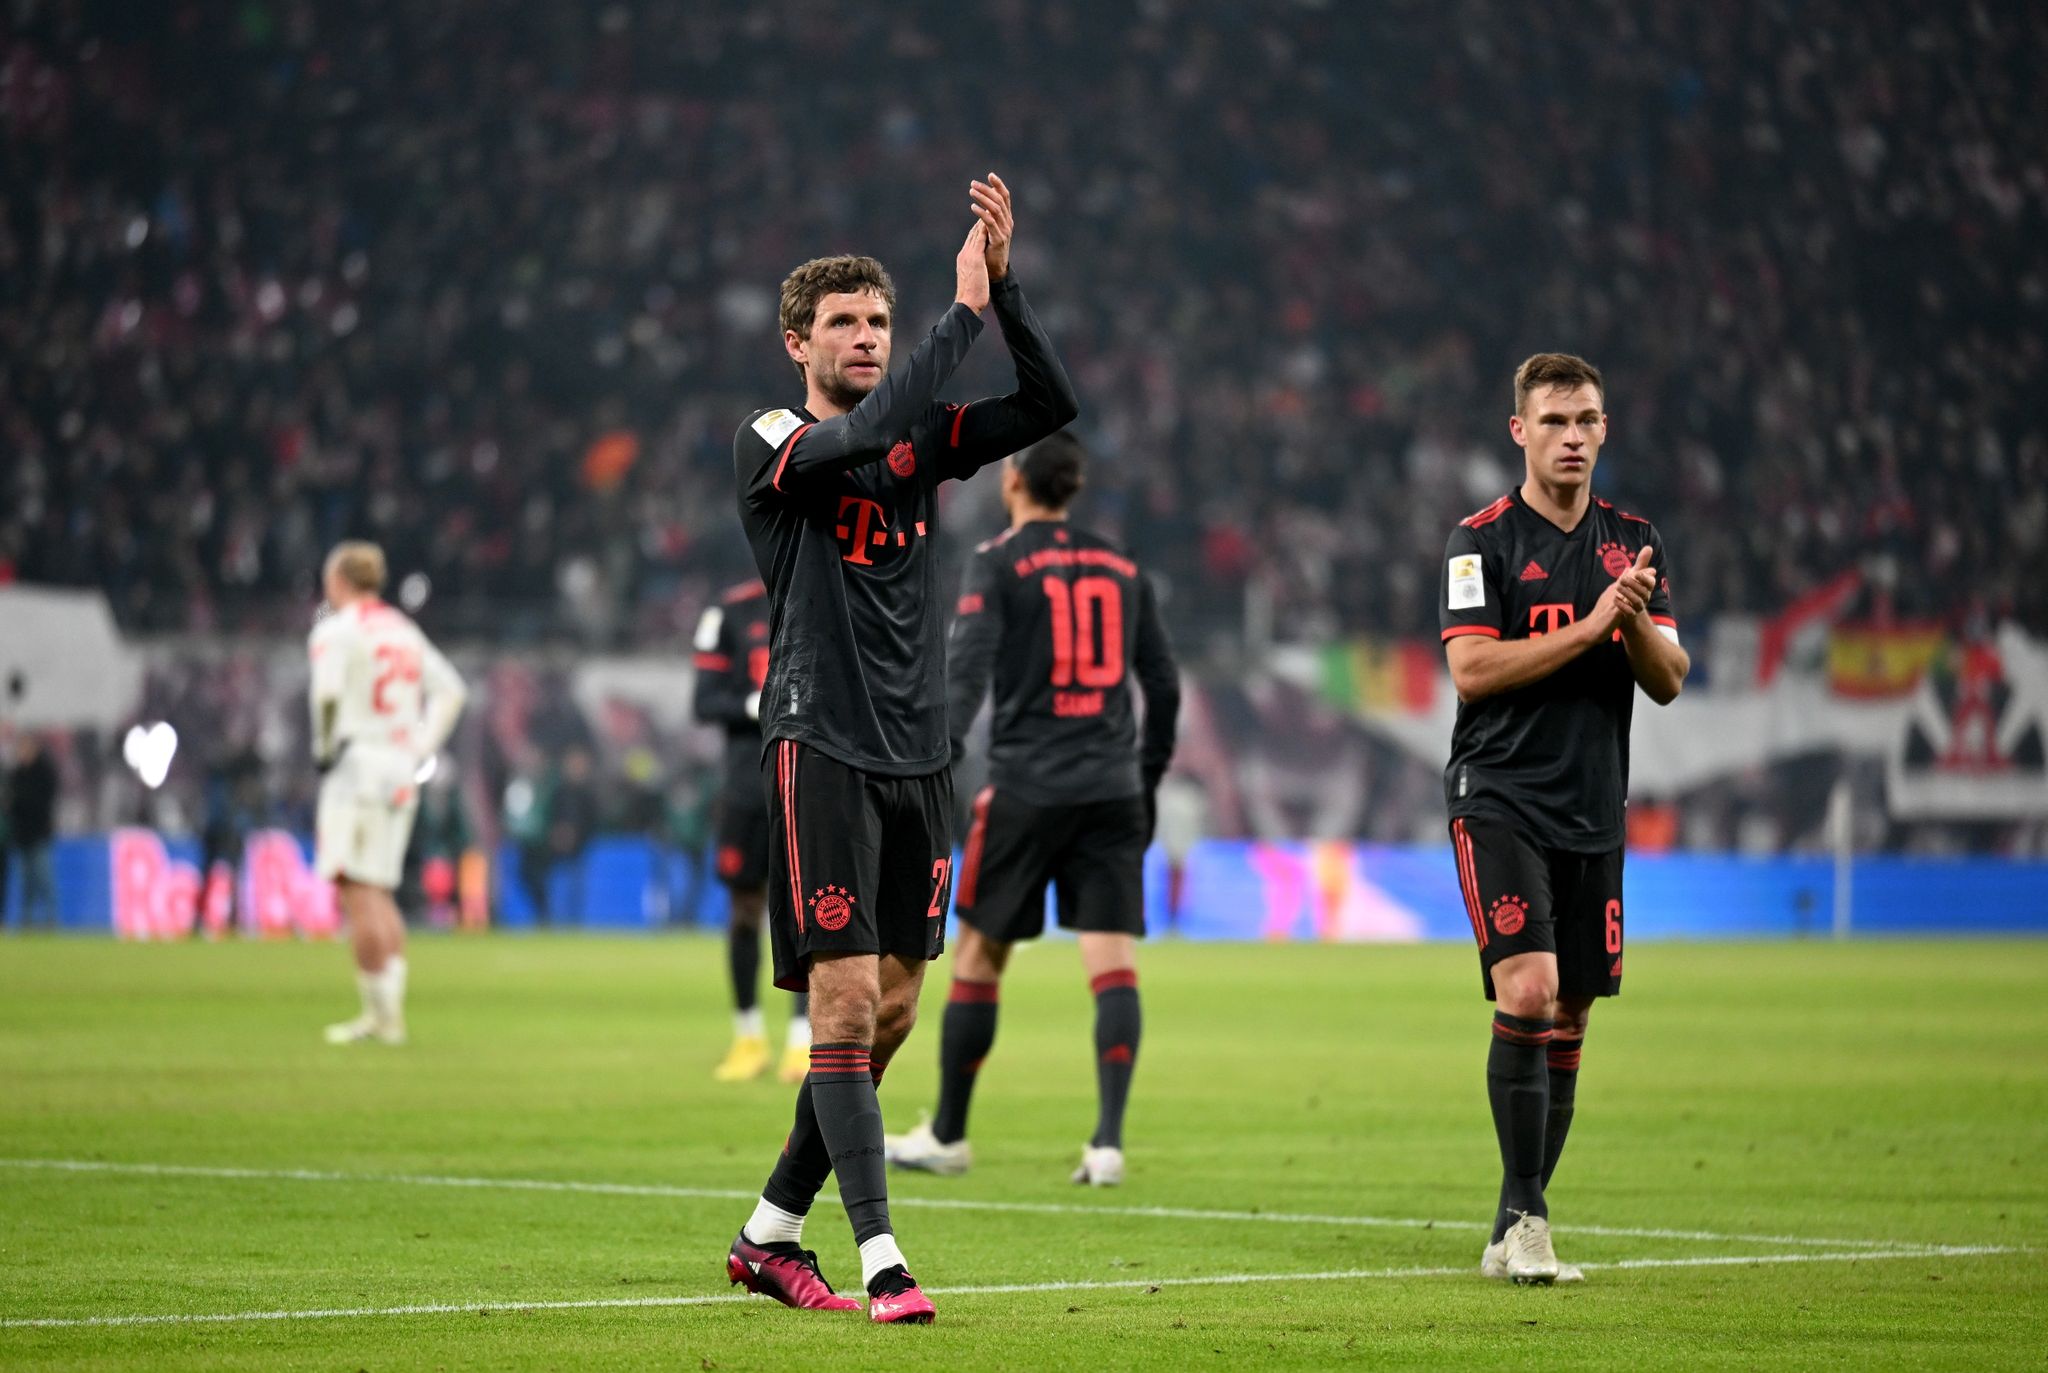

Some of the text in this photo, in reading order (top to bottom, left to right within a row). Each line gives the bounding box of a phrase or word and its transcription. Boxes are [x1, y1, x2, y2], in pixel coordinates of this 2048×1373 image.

[1042, 575, 1124, 687] 10
[825, 897, 848, 910] BAYERN
[1606, 899, 1621, 953] 6
